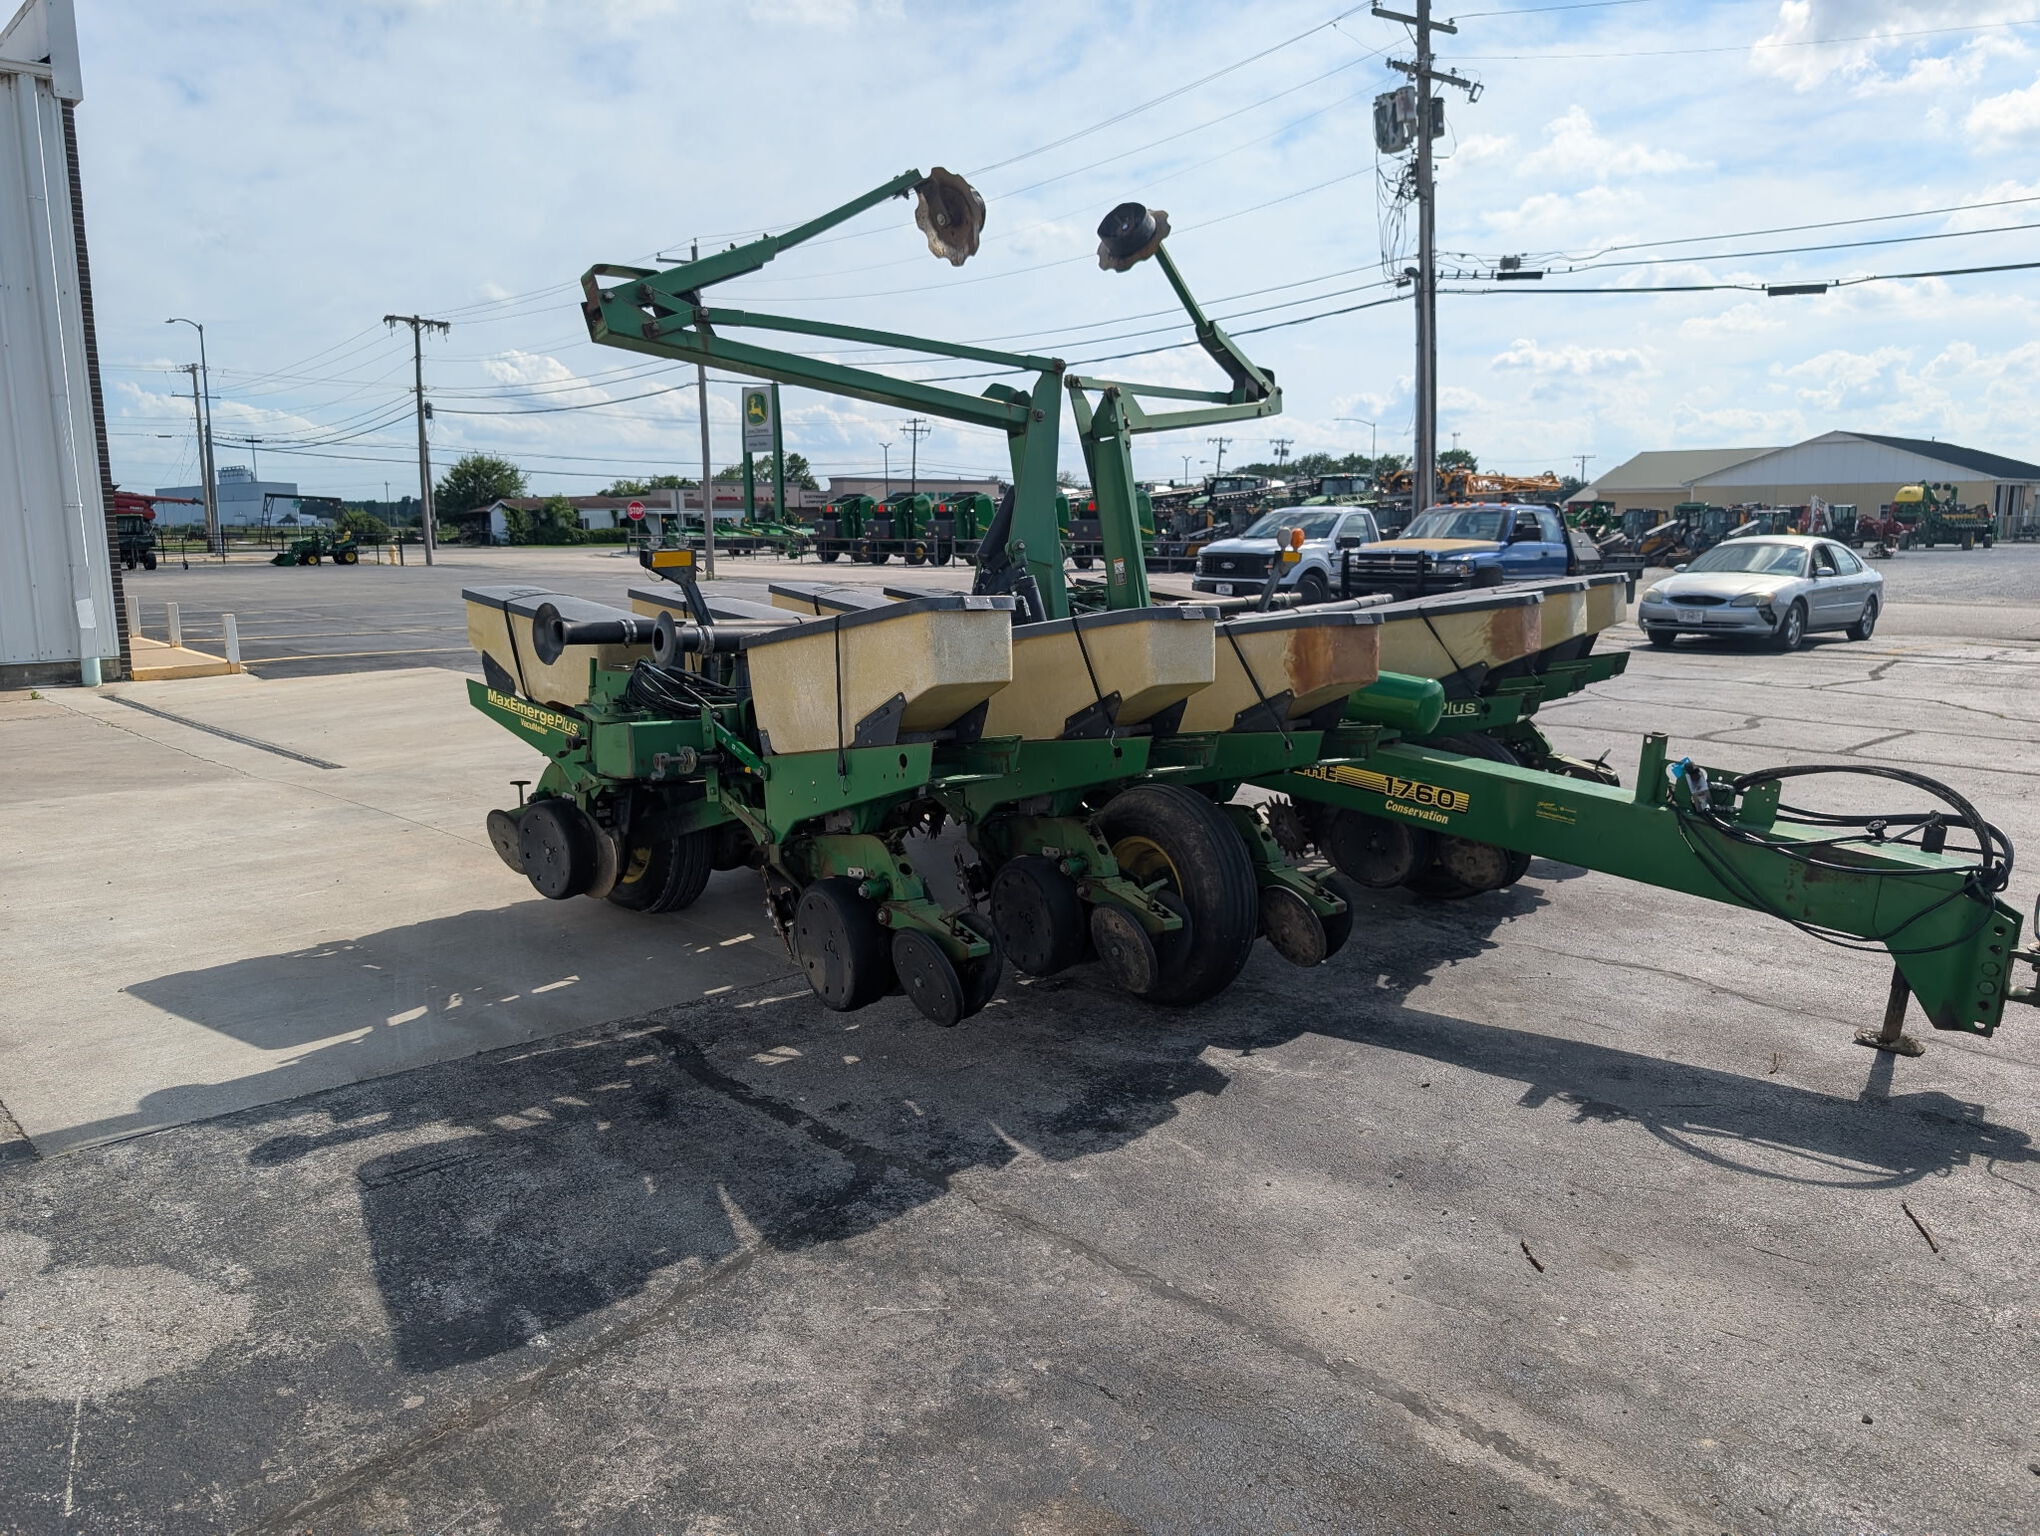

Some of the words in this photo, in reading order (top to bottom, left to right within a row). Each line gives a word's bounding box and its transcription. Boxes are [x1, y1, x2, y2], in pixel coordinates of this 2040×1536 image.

[629, 506, 645, 515] STOP
[487, 688, 579, 734] MaxEmergePlus
[1385, 776, 1456, 810] 1760
[1385, 800, 1448, 824] Conservation
